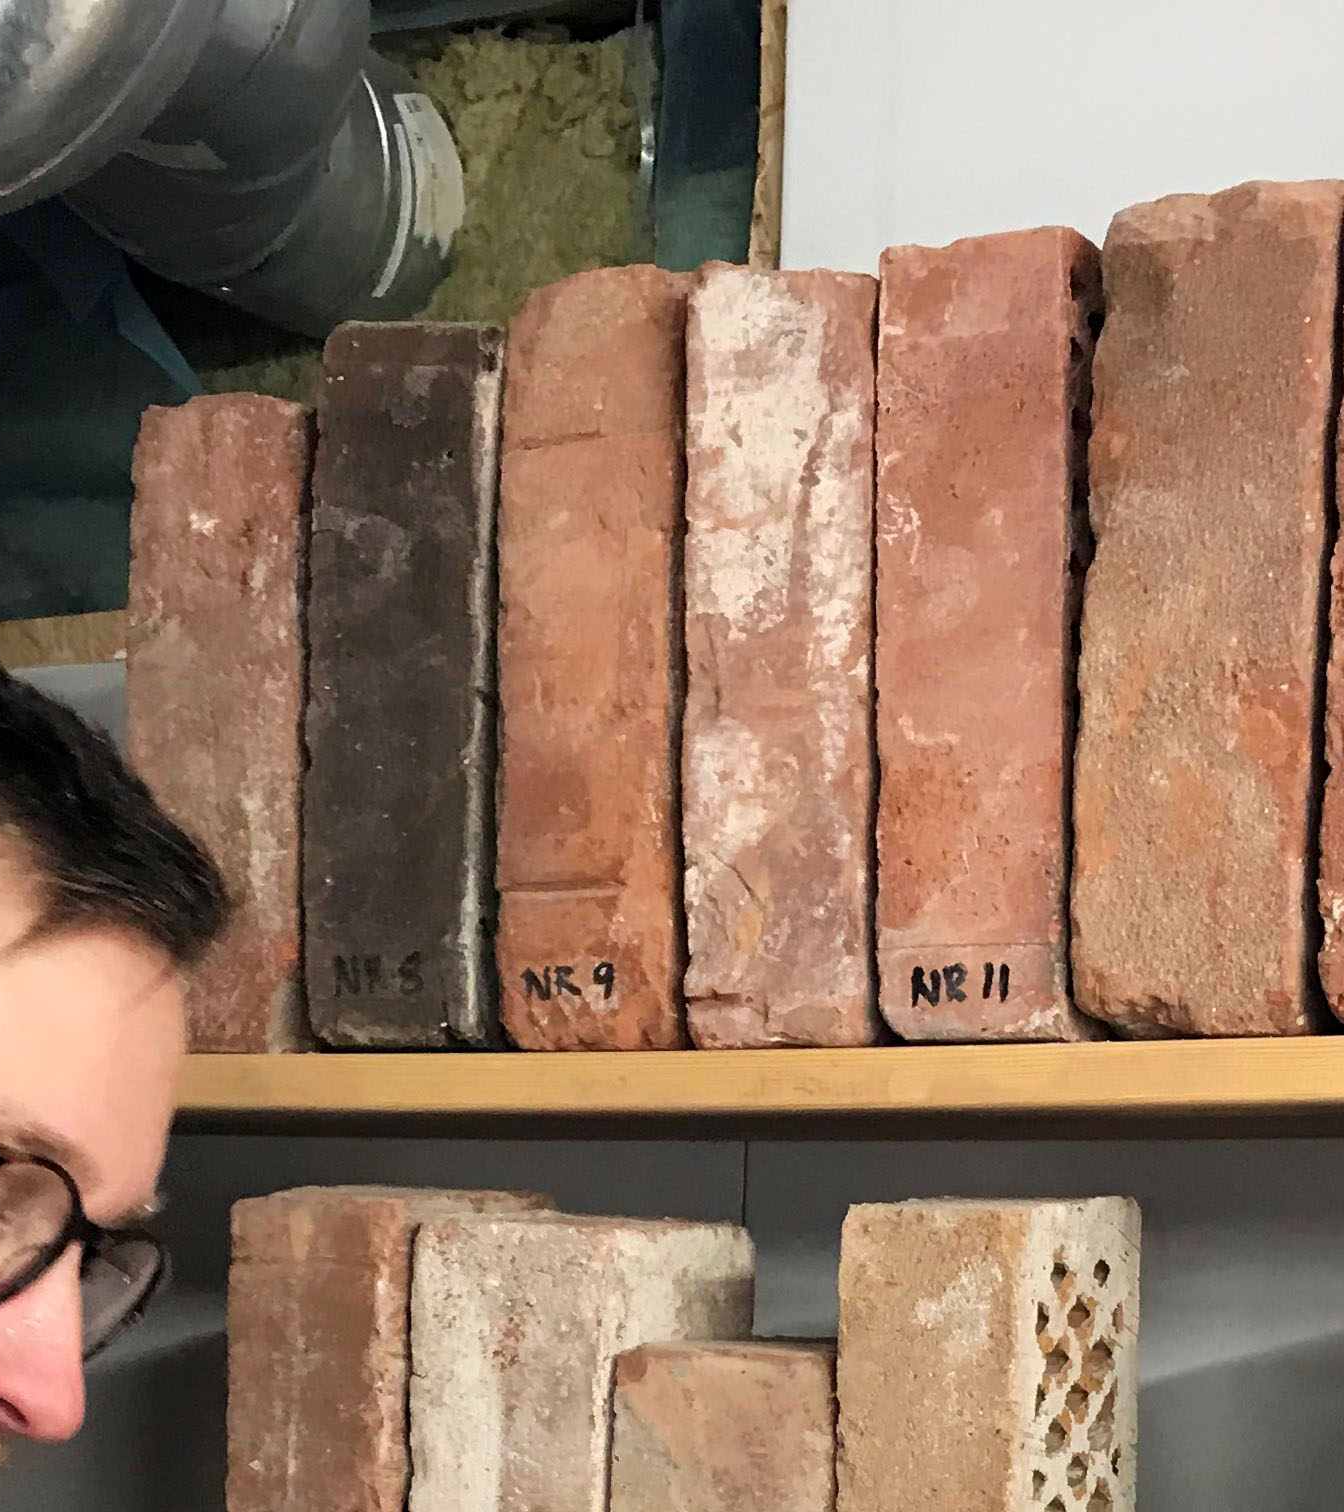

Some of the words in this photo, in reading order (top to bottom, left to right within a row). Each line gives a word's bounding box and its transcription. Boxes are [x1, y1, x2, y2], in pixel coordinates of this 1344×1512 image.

[520, 965, 582, 1001] NR
[592, 961, 615, 1000] 9
[911, 962, 968, 1008] NR
[982, 961, 1010, 1004] 11
